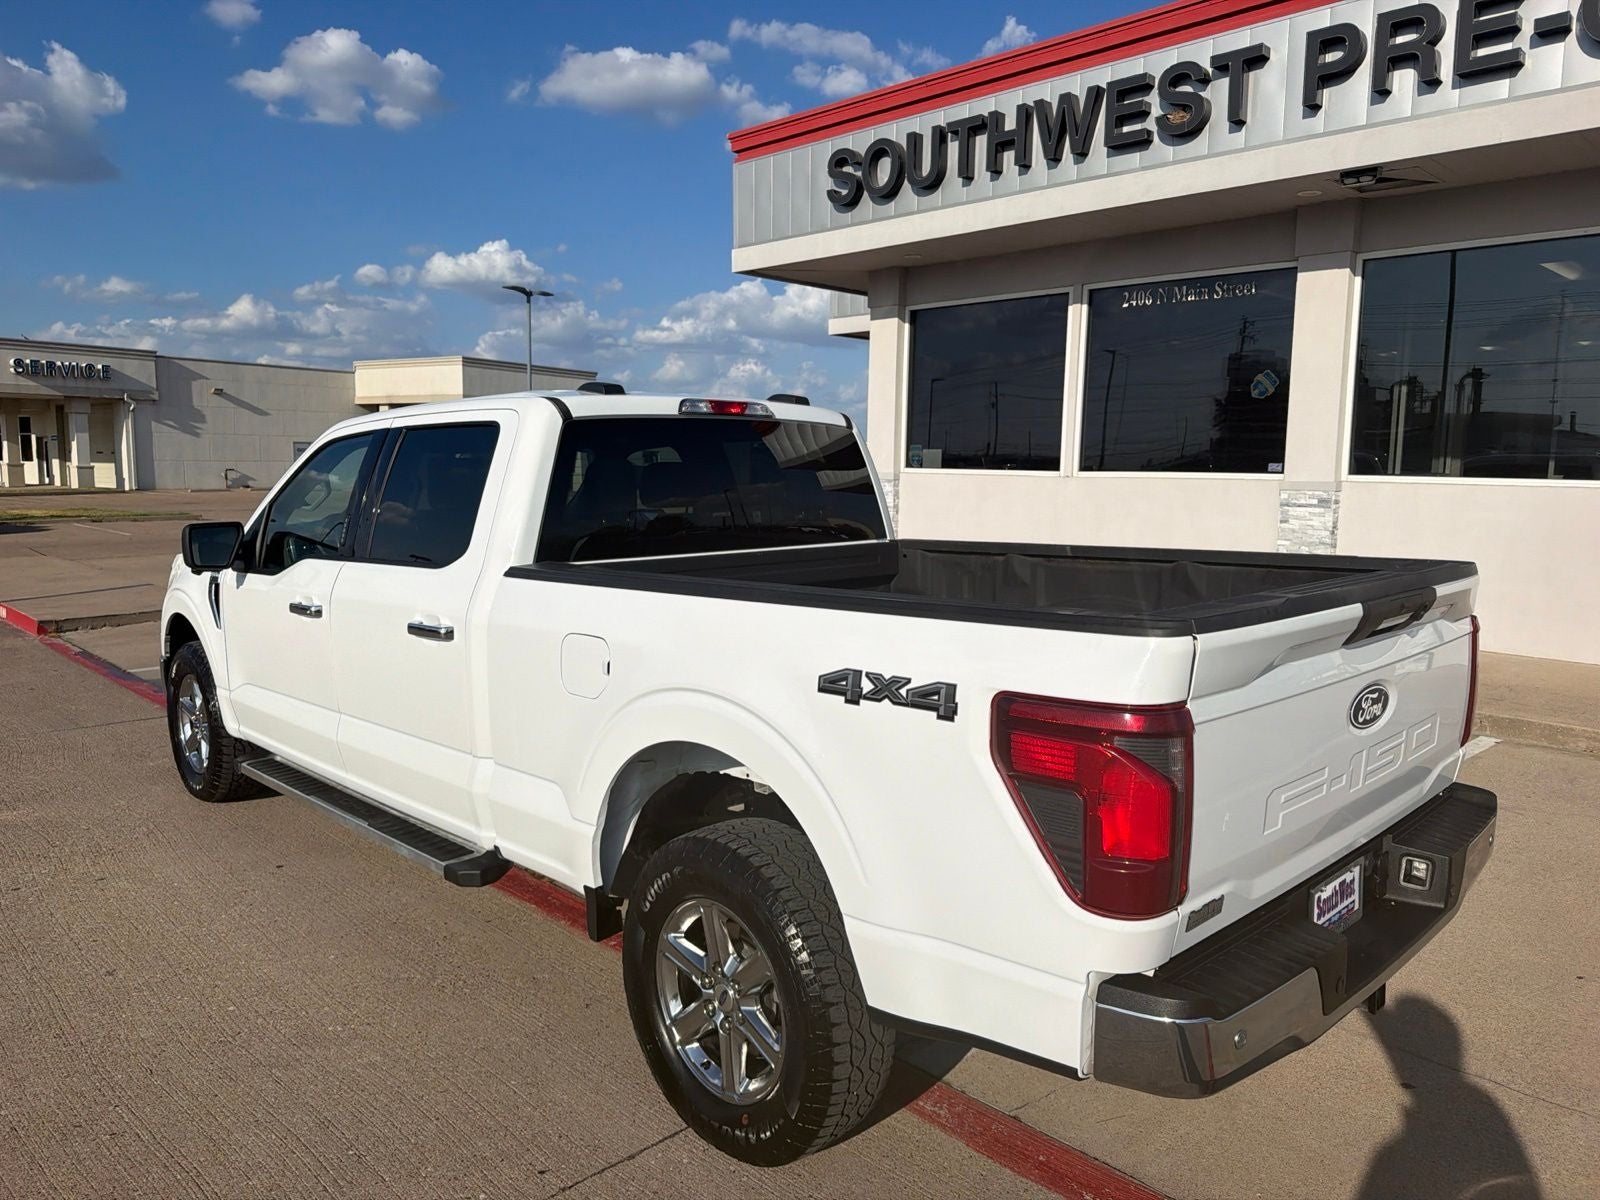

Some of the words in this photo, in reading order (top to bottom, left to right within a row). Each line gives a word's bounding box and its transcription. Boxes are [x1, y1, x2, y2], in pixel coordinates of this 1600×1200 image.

[826, 43, 1270, 205] SOUTHWEST
[1302, 0, 1600, 111] PRE-
[1122, 289, 1153, 308] 2406
[1156, 287, 1168, 304] N
[1172, 283, 1209, 303] Main
[1213, 280, 1256, 299] Street
[9, 357, 112, 380] SERVICE
[1263, 712, 1440, 836] F-150
